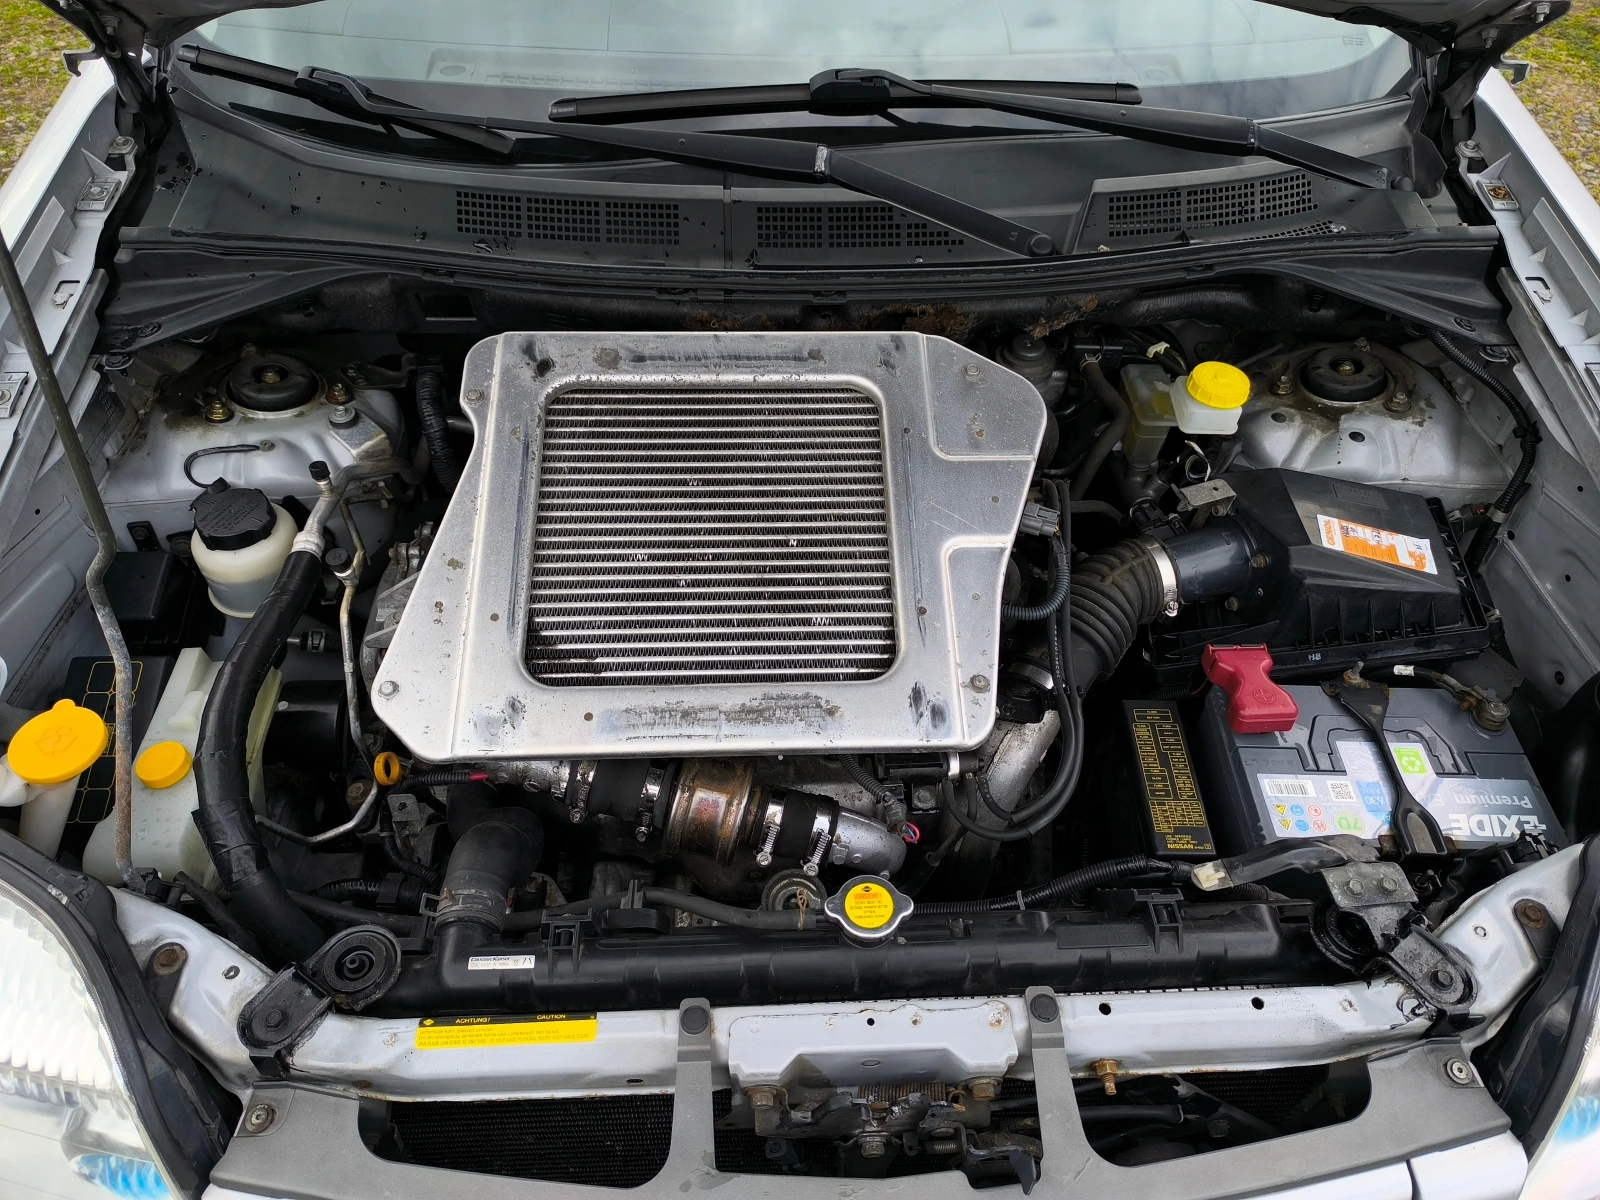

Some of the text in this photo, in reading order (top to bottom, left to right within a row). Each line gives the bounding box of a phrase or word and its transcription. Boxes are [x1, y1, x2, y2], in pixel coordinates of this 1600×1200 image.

[1323, 519, 1336, 547] GENOL
[1364, 796, 1384, 805] 630
[1453, 793, 1533, 809] Premium
[1448, 813, 1547, 837] EXIDE
